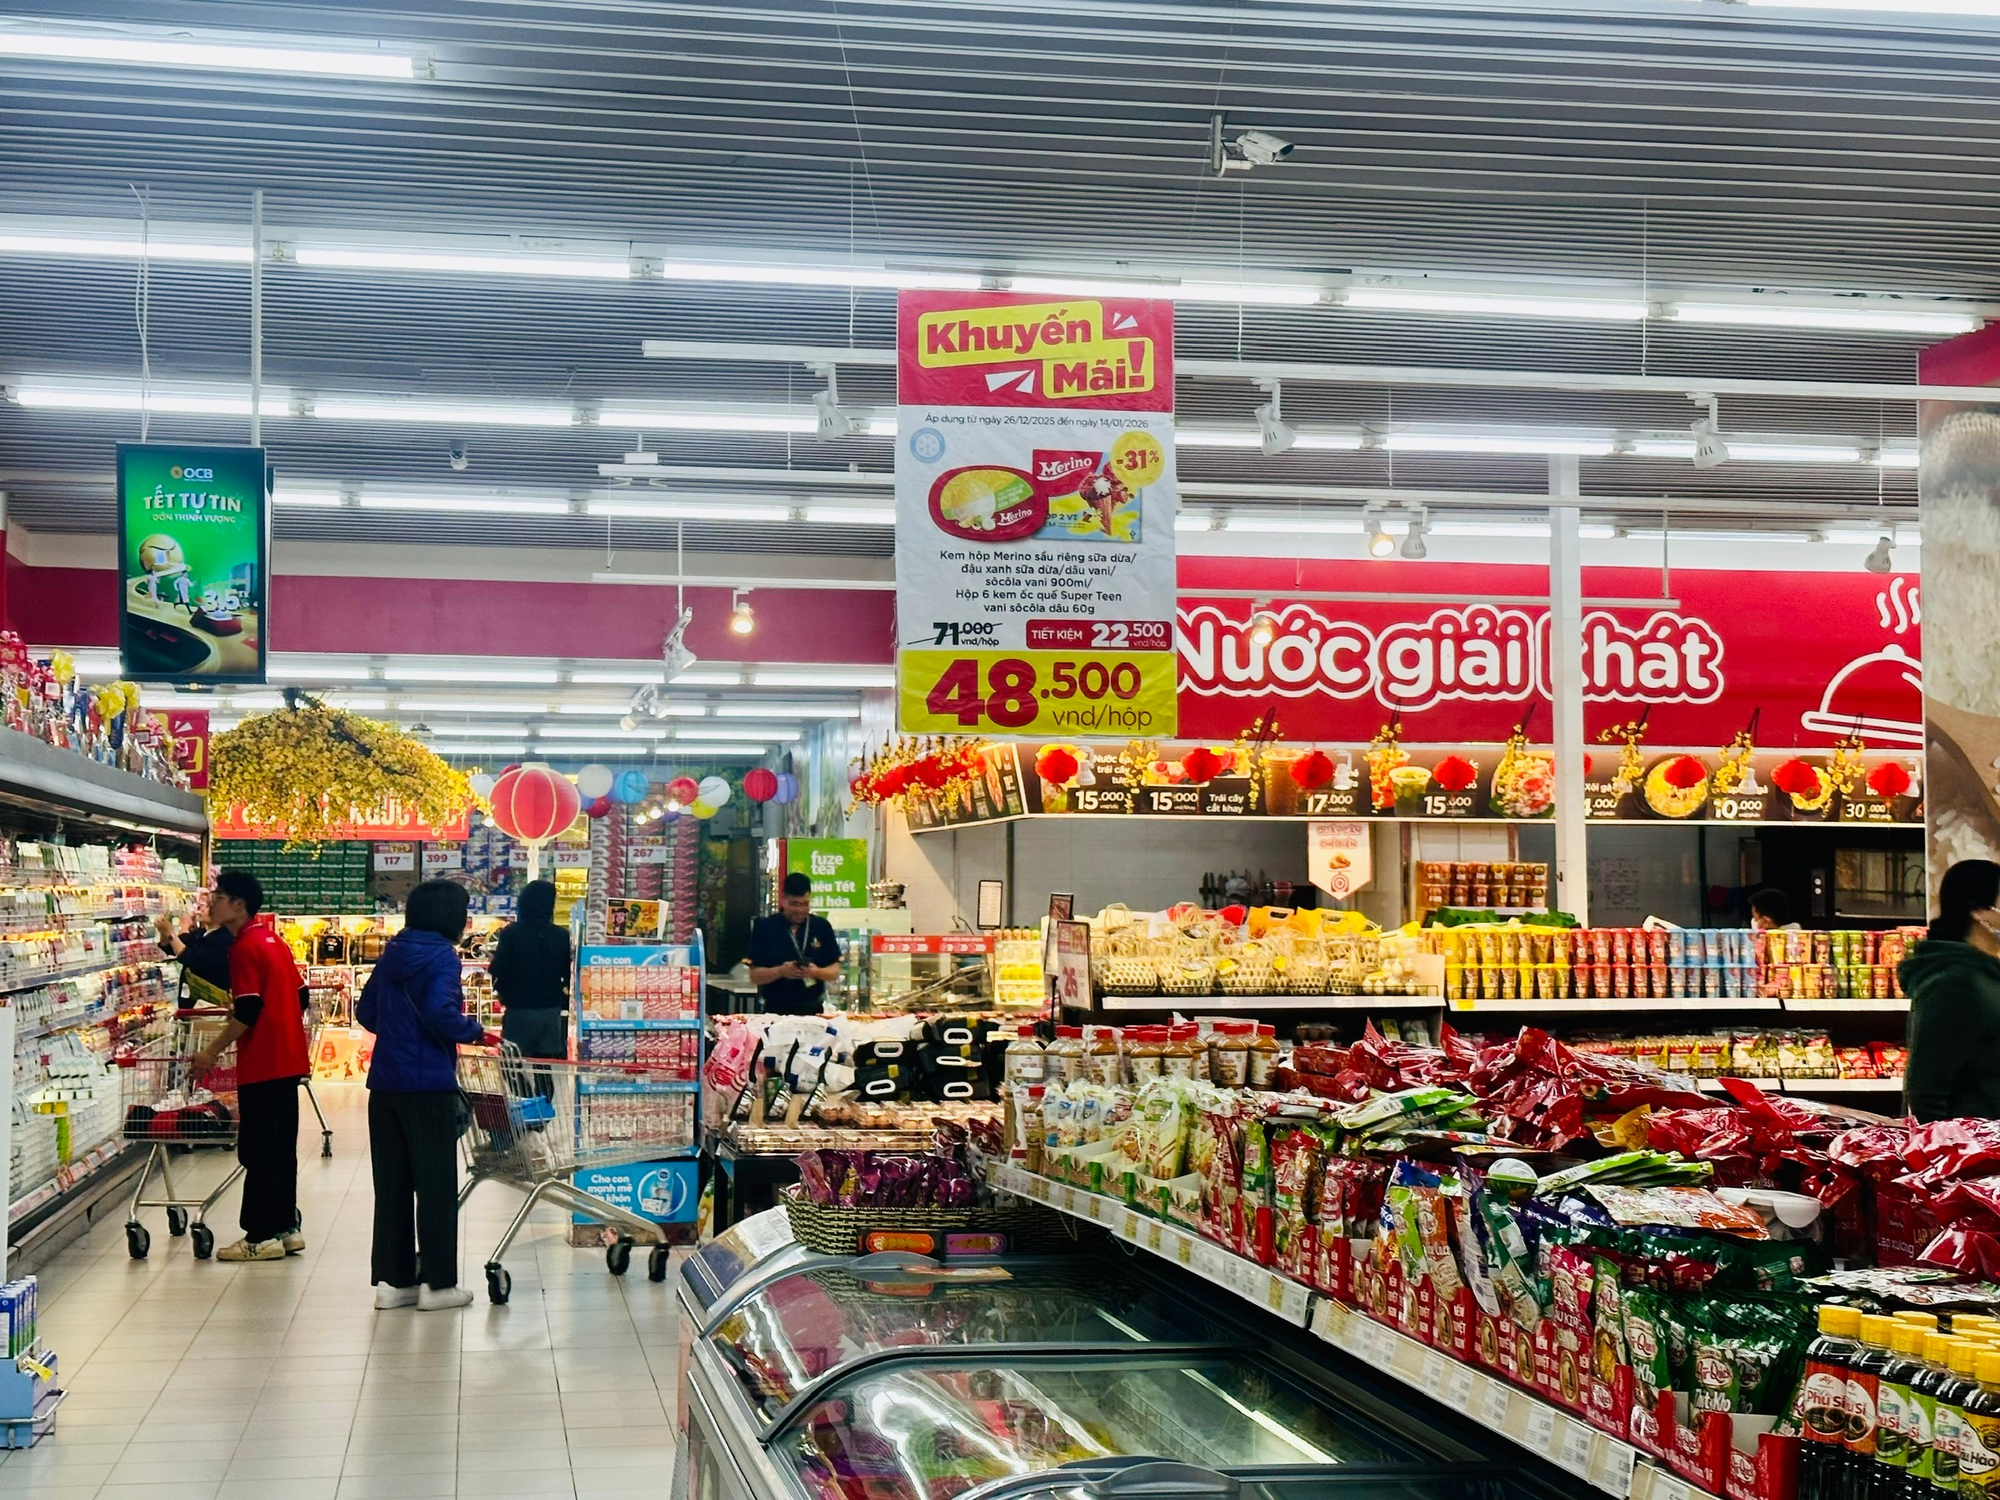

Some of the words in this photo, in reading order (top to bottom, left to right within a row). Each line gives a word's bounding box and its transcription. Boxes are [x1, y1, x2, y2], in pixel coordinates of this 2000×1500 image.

[927, 309, 1092, 355] Khuyến
[1053, 341, 1145, 393] Mãi!
[980, 416, 1002, 426] ngày
[1004, 415, 1055, 426] 26/12/2025
[1076, 418, 1098, 428] ngày
[1100, 418, 1149, 429] 14/01/2026
[1038, 456, 1093, 478] Merino
[1116, 449, 1160, 471] -31%
[183, 467, 213, 479] OCB
[143, 484, 175, 510] TẾT
[179, 492, 207, 514] TỰ
[208, 494, 242, 512] TIN
[999, 508, 1033, 524] Merino
[940, 551, 965, 562] Kem
[969, 551, 992, 564] hộp
[994, 551, 1032, 562] Merino
[1057, 552, 1085, 565] riêng
[1088, 553, 1107, 564] sữa
[1110, 553, 1137, 565] dừa/
[961, 564, 983, 577] đậu
[986, 565, 1012, 575] xanh
[1015, 565, 1034, 575] sữa
[1088, 565, 1116, 577] vani/
[985, 577, 1022, 588] sôcôla
[1025, 577, 1048, 588] vani
[1050, 578, 1093, 589] 900ml/
[956, 589, 979, 603] Hộp
[982, 590, 990, 600] 6
[993, 590, 1017, 600] kem
[1020, 587, 1034, 600] ốc
[1037, 588, 1058, 603] quế
[1060, 591, 1093, 603] Super
[1096, 591, 1122, 602] Teen
[983, 603, 1006, 613] vani
[1010, 603, 1046, 614] sôcôla
[1049, 603, 1069, 614] dâu
[1072, 604, 1095, 615] 60g
[1031, 626, 1055, 640] TIẾT
[1056, 628, 1083, 642] KIỆM
[1091, 623, 1165, 648] 22.500
[1177, 614, 1369, 689] Nước
[1385, 615, 1522, 699] giải
[1577, 624, 1712, 692] hát
[926, 658, 1142, 728] 48.500
[1052, 704, 1152, 730] vnd/hộp
[1075, 790, 1125, 811] 15.000
[1150, 791, 1198, 811] 15.000
[1305, 794, 1354, 814] 17.000
[1222, 803, 1244, 814] khay
[1845, 803, 1886, 818] 30.000
[426, 854, 448, 863] 399
[513, 852, 528, 862] 33
[558, 853, 579, 863] 375
[632, 848, 654, 858] 267
[811, 850, 844, 865] fuze
[383, 856, 400, 866] 117
[811, 863, 836, 876] tea
[590, 955, 611, 965] Cho
[612, 956, 631, 965] con
[591, 1174, 611, 1183] Cho
[1971, 1451, 1998, 1467] Hào
